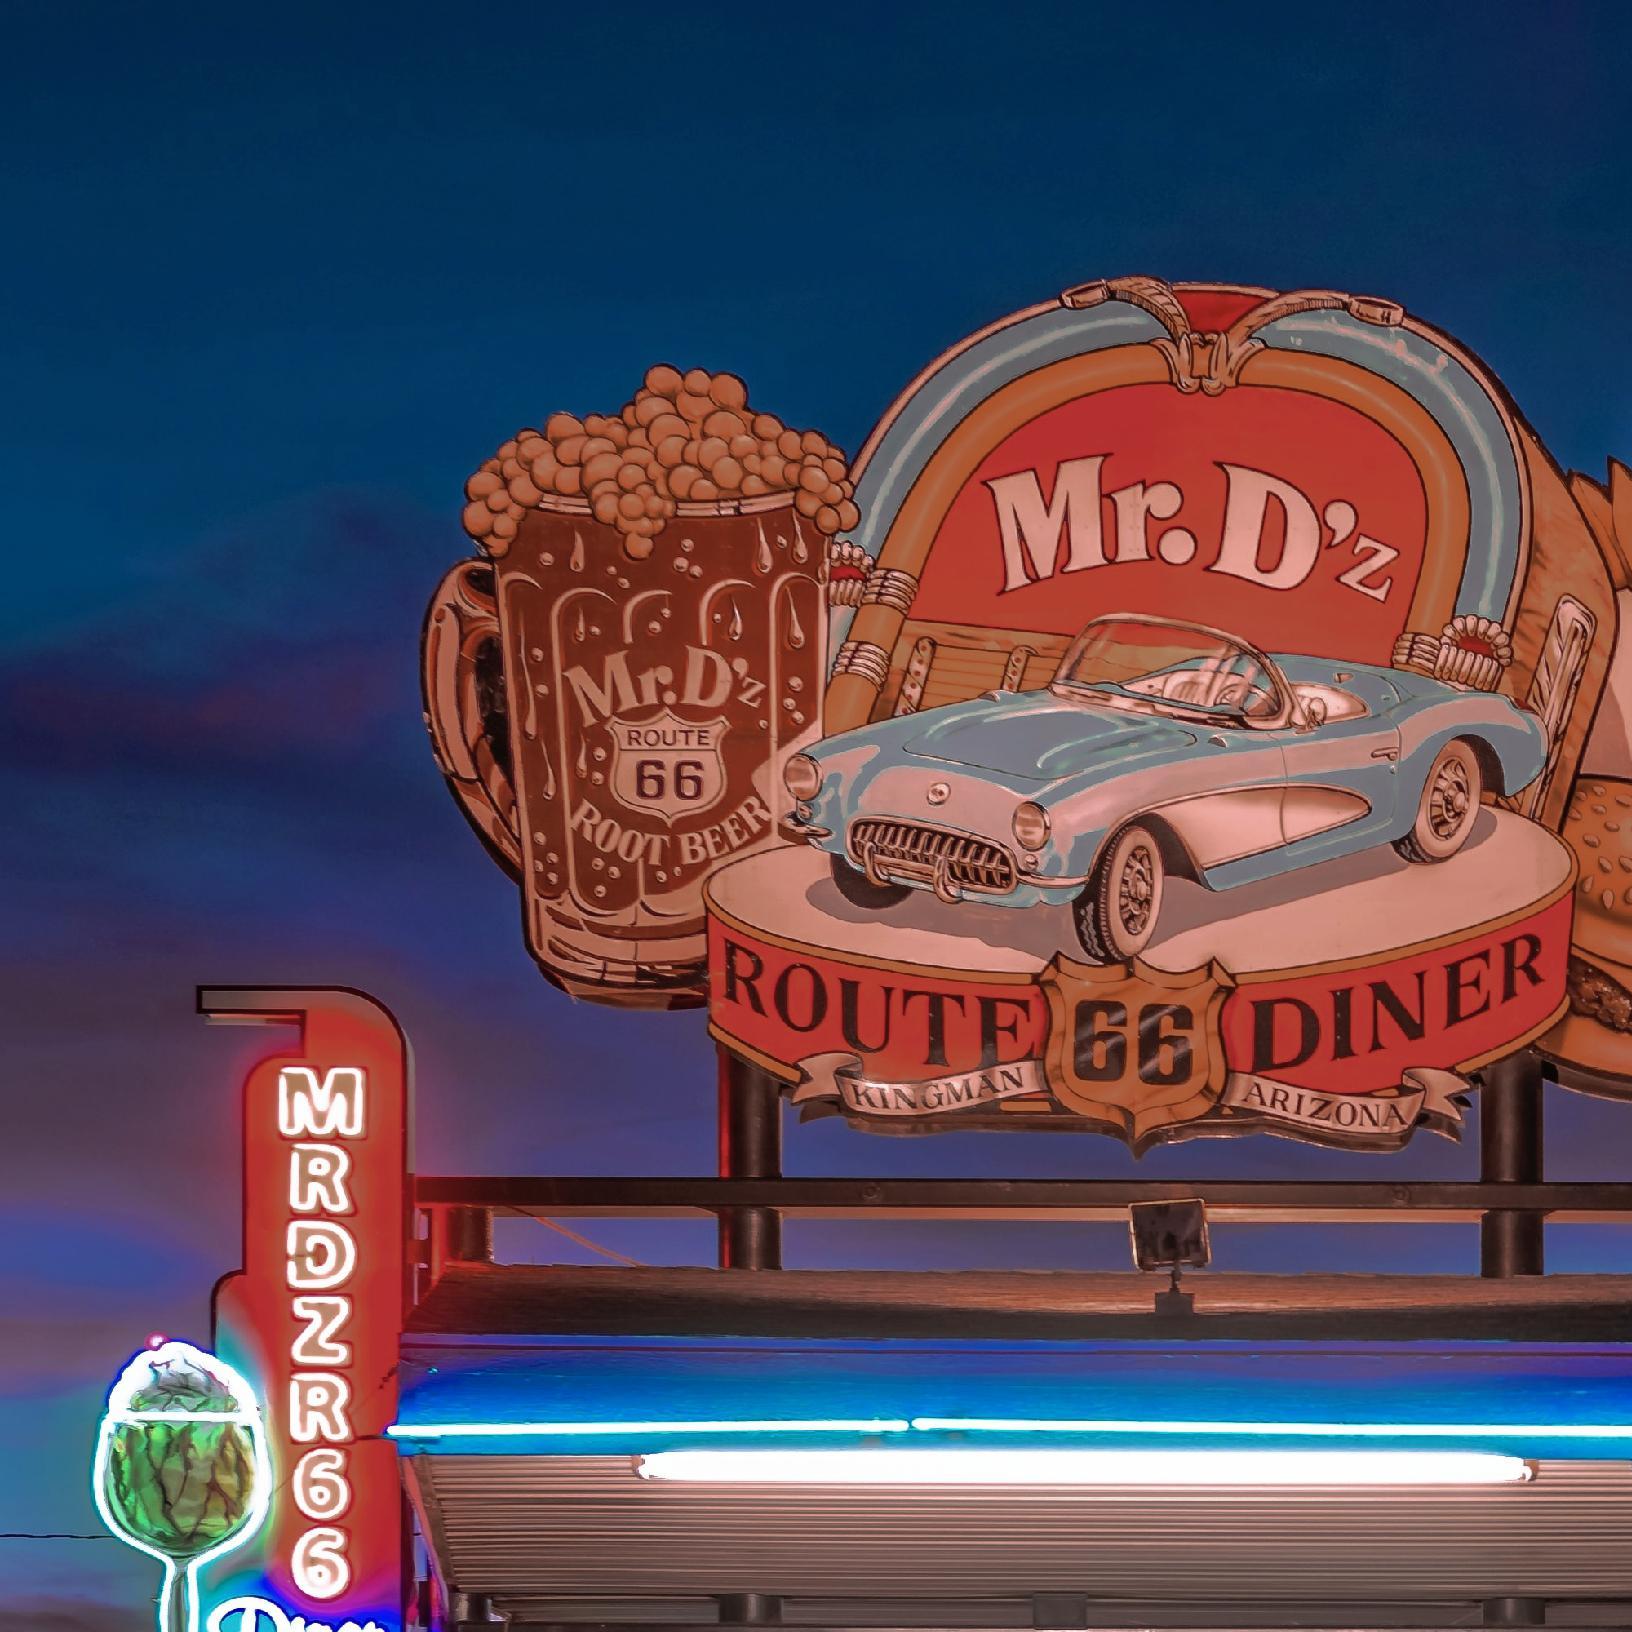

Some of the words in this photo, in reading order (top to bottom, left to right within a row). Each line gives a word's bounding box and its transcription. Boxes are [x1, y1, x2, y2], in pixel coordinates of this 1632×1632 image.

[980, 452, 1198, 596] Mr.
[1204, 461, 1401, 603] D'z
[562, 650, 677, 727] Mr.
[680, 645, 766, 708] D'z
[627, 729, 710, 747] ROUTE
[636, 759, 704, 800] 66
[571, 799, 671, 866] ROOT
[677, 796, 772, 866] BEER
[723, 937, 1036, 1068] ROUTE
[1074, 1000, 1194, 1085] 66
[1250, 933, 1546, 1074] DINER
[851, 1066, 1025, 1111] KINGMAN
[1246, 1082, 1409, 1130] ARIZONA
